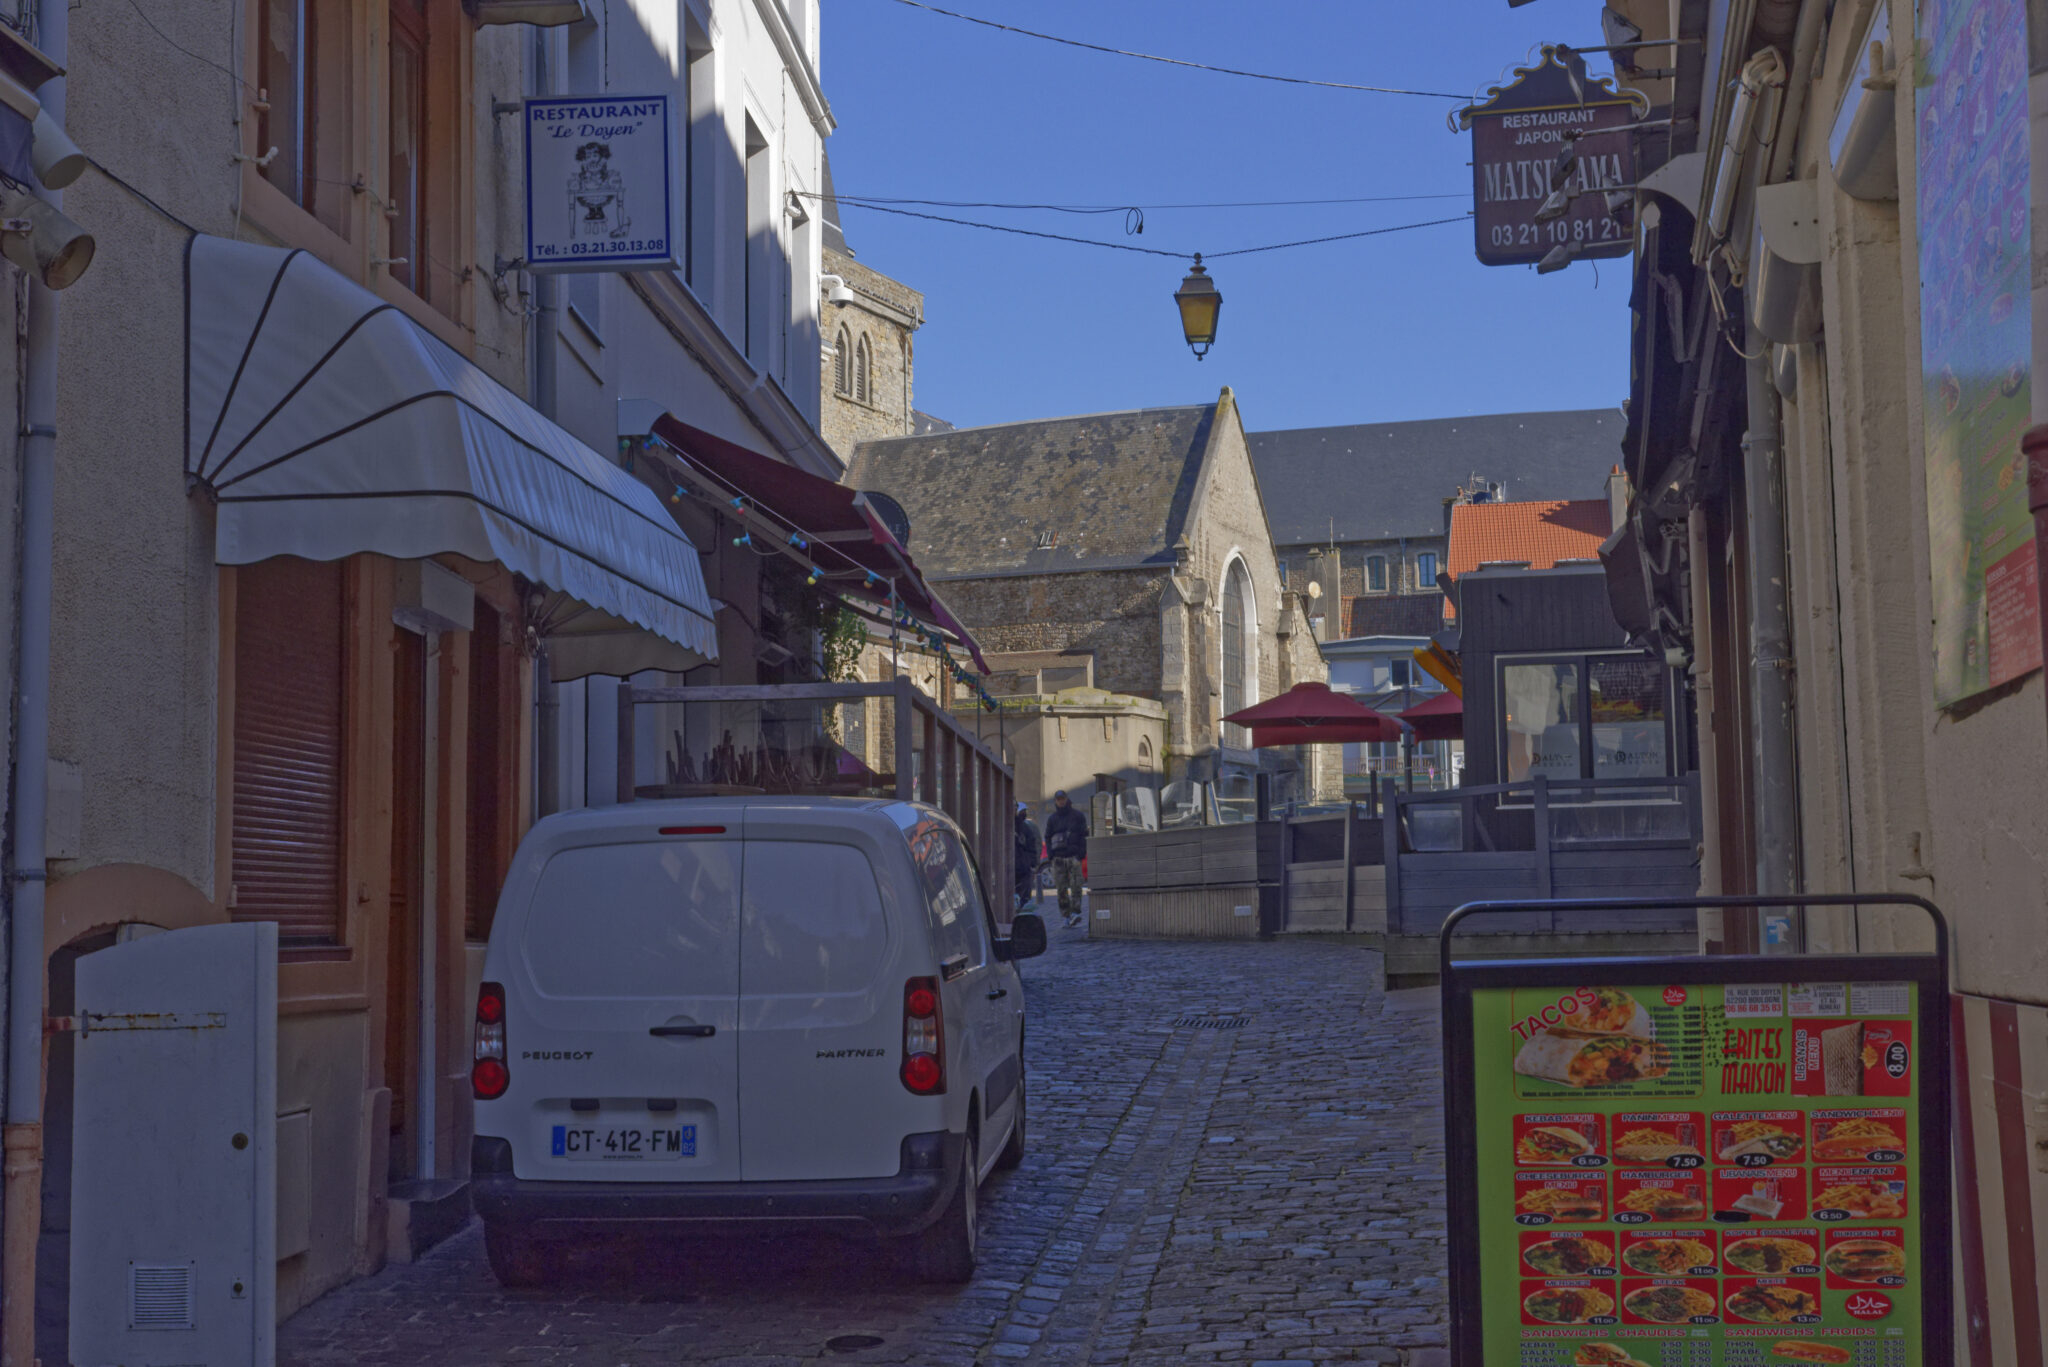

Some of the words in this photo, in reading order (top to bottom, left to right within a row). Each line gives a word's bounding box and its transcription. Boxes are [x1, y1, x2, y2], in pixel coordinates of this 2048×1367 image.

[533, 104, 660, 121] RESTAURANT
[1503, 109, 1596, 128] RESTAURANT
[1515, 128, 1585, 145] JAPONS
[1492, 225, 1513, 246] 03
[1519, 223, 1539, 245] 21
[1547, 221, 1567, 242] 10
[1574, 219, 1593, 240] 81
[1601, 217, 1621, 239] 21
[536, 244, 560, 256] Tél.
[571, 239, 664, 254] 03.21.30.13.08
[1510, 985, 1598, 1041] TACOS
[816, 1048, 886, 1058] PARTNER
[1722, 1028, 1783, 1060] FRITES
[522, 1051, 594, 1060] PEUGEOT
[1795, 1029, 1807, 1081] LIBANAIS
[1808, 1037, 1820, 1070] MENU
[1888, 1047, 1905, 1073] 8.00
[1721, 1062, 1786, 1094] MAISON
[567, 1130, 680, 1152] CT-412-FM
[1673, 1157, 1697, 1167] 7.50
[1743, 1156, 1766, 1166] 7.50
[1521, 1329, 1609, 1338] SANDWICHS
[1725, 1328, 1814, 1336] SANDWICHS
[1821, 1327, 1876, 1336] FROIDS
